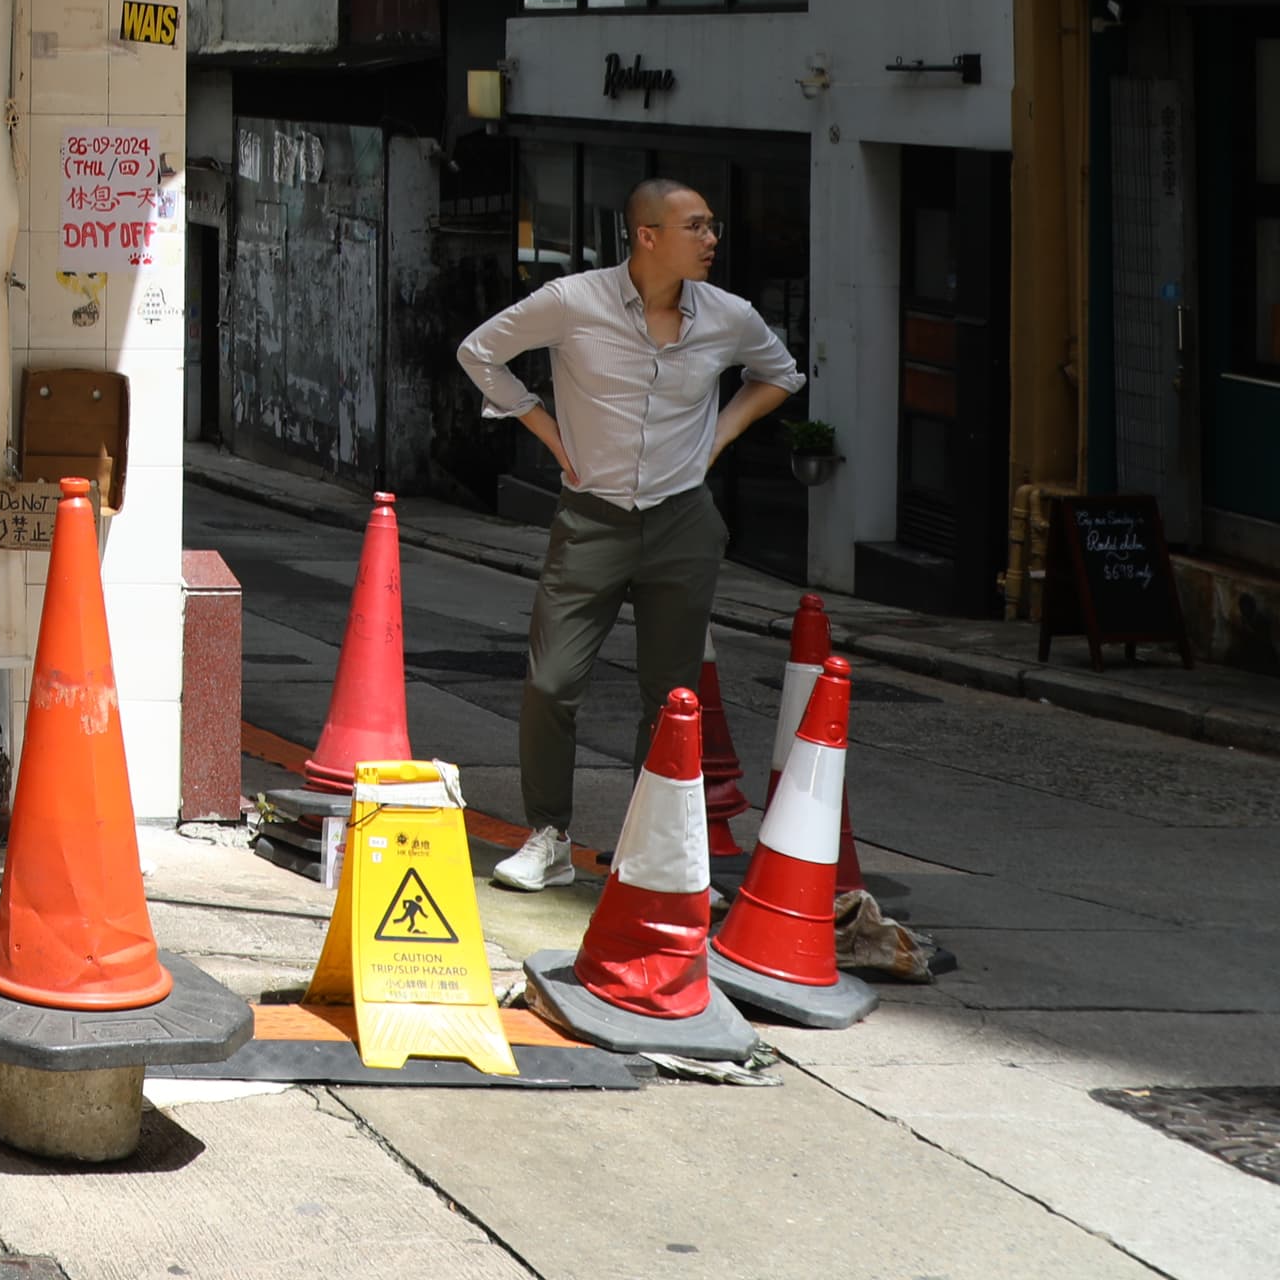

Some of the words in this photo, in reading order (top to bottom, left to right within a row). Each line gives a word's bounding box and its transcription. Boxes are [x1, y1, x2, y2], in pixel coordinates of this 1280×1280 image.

[123, 2, 177, 45] WAIS
[68, 136, 151, 156] 26-09-2024
[67, 185, 157, 213] 休息一天
[63, 222, 116, 249] DAY
[120, 222, 158, 248] OFF
[11, 515, 55, 542] 禁止
[371, 963, 420, 975] TRIP/SLIP
[422, 966, 468, 977] HAZARD
[393, 952, 443, 963] CAUTION
